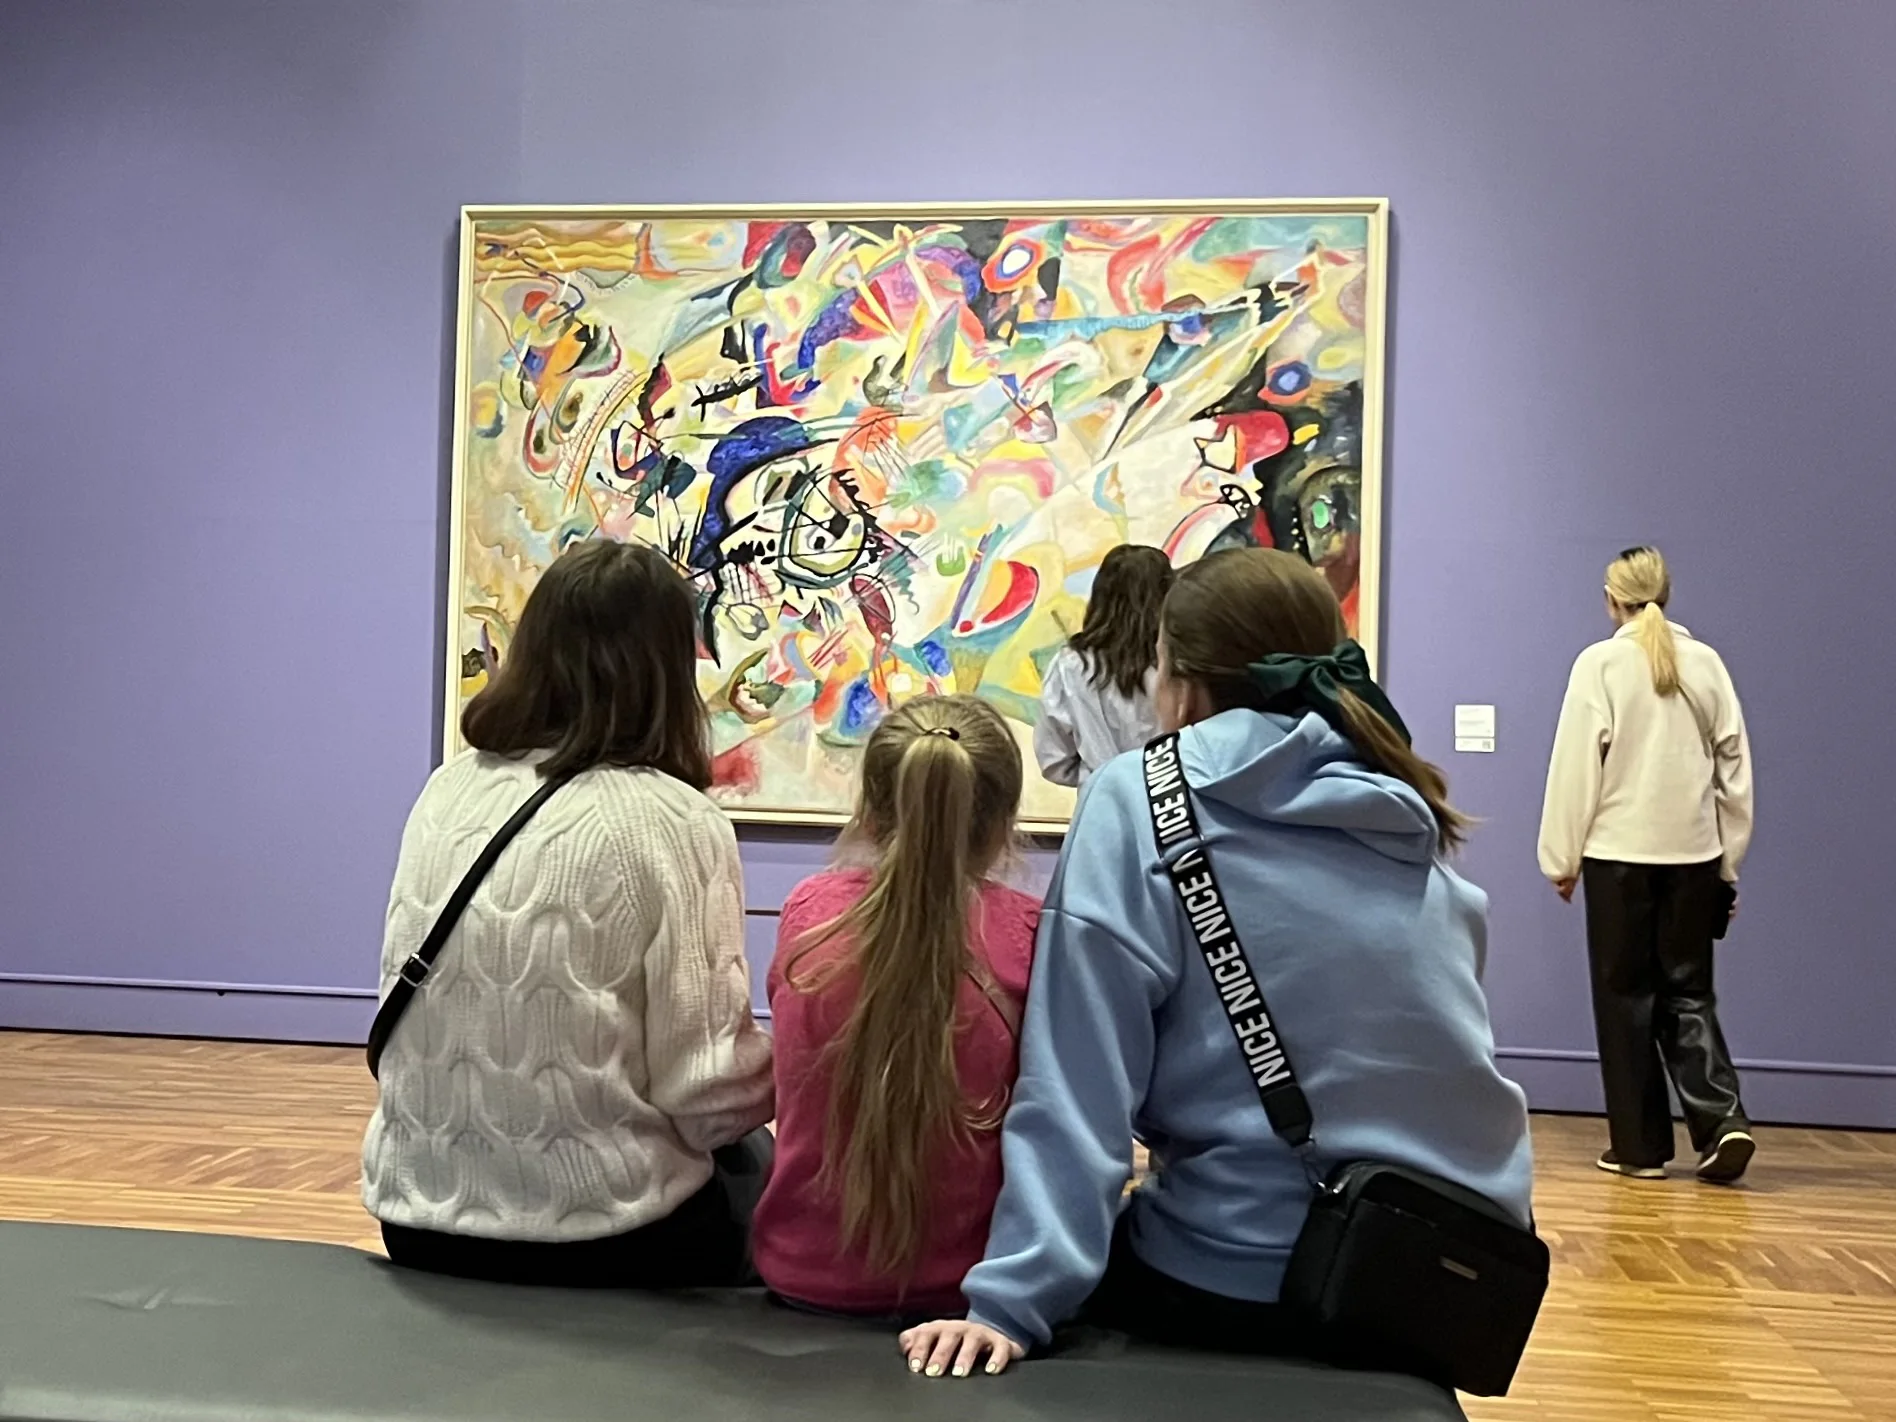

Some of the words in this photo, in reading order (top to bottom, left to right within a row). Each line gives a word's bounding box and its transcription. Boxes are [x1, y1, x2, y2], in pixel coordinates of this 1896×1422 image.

[1145, 737, 1182, 797] NICE
[1179, 872, 1231, 944] NICE
[1206, 941, 1261, 1015] NICE
[1235, 1012, 1291, 1087] NICE
